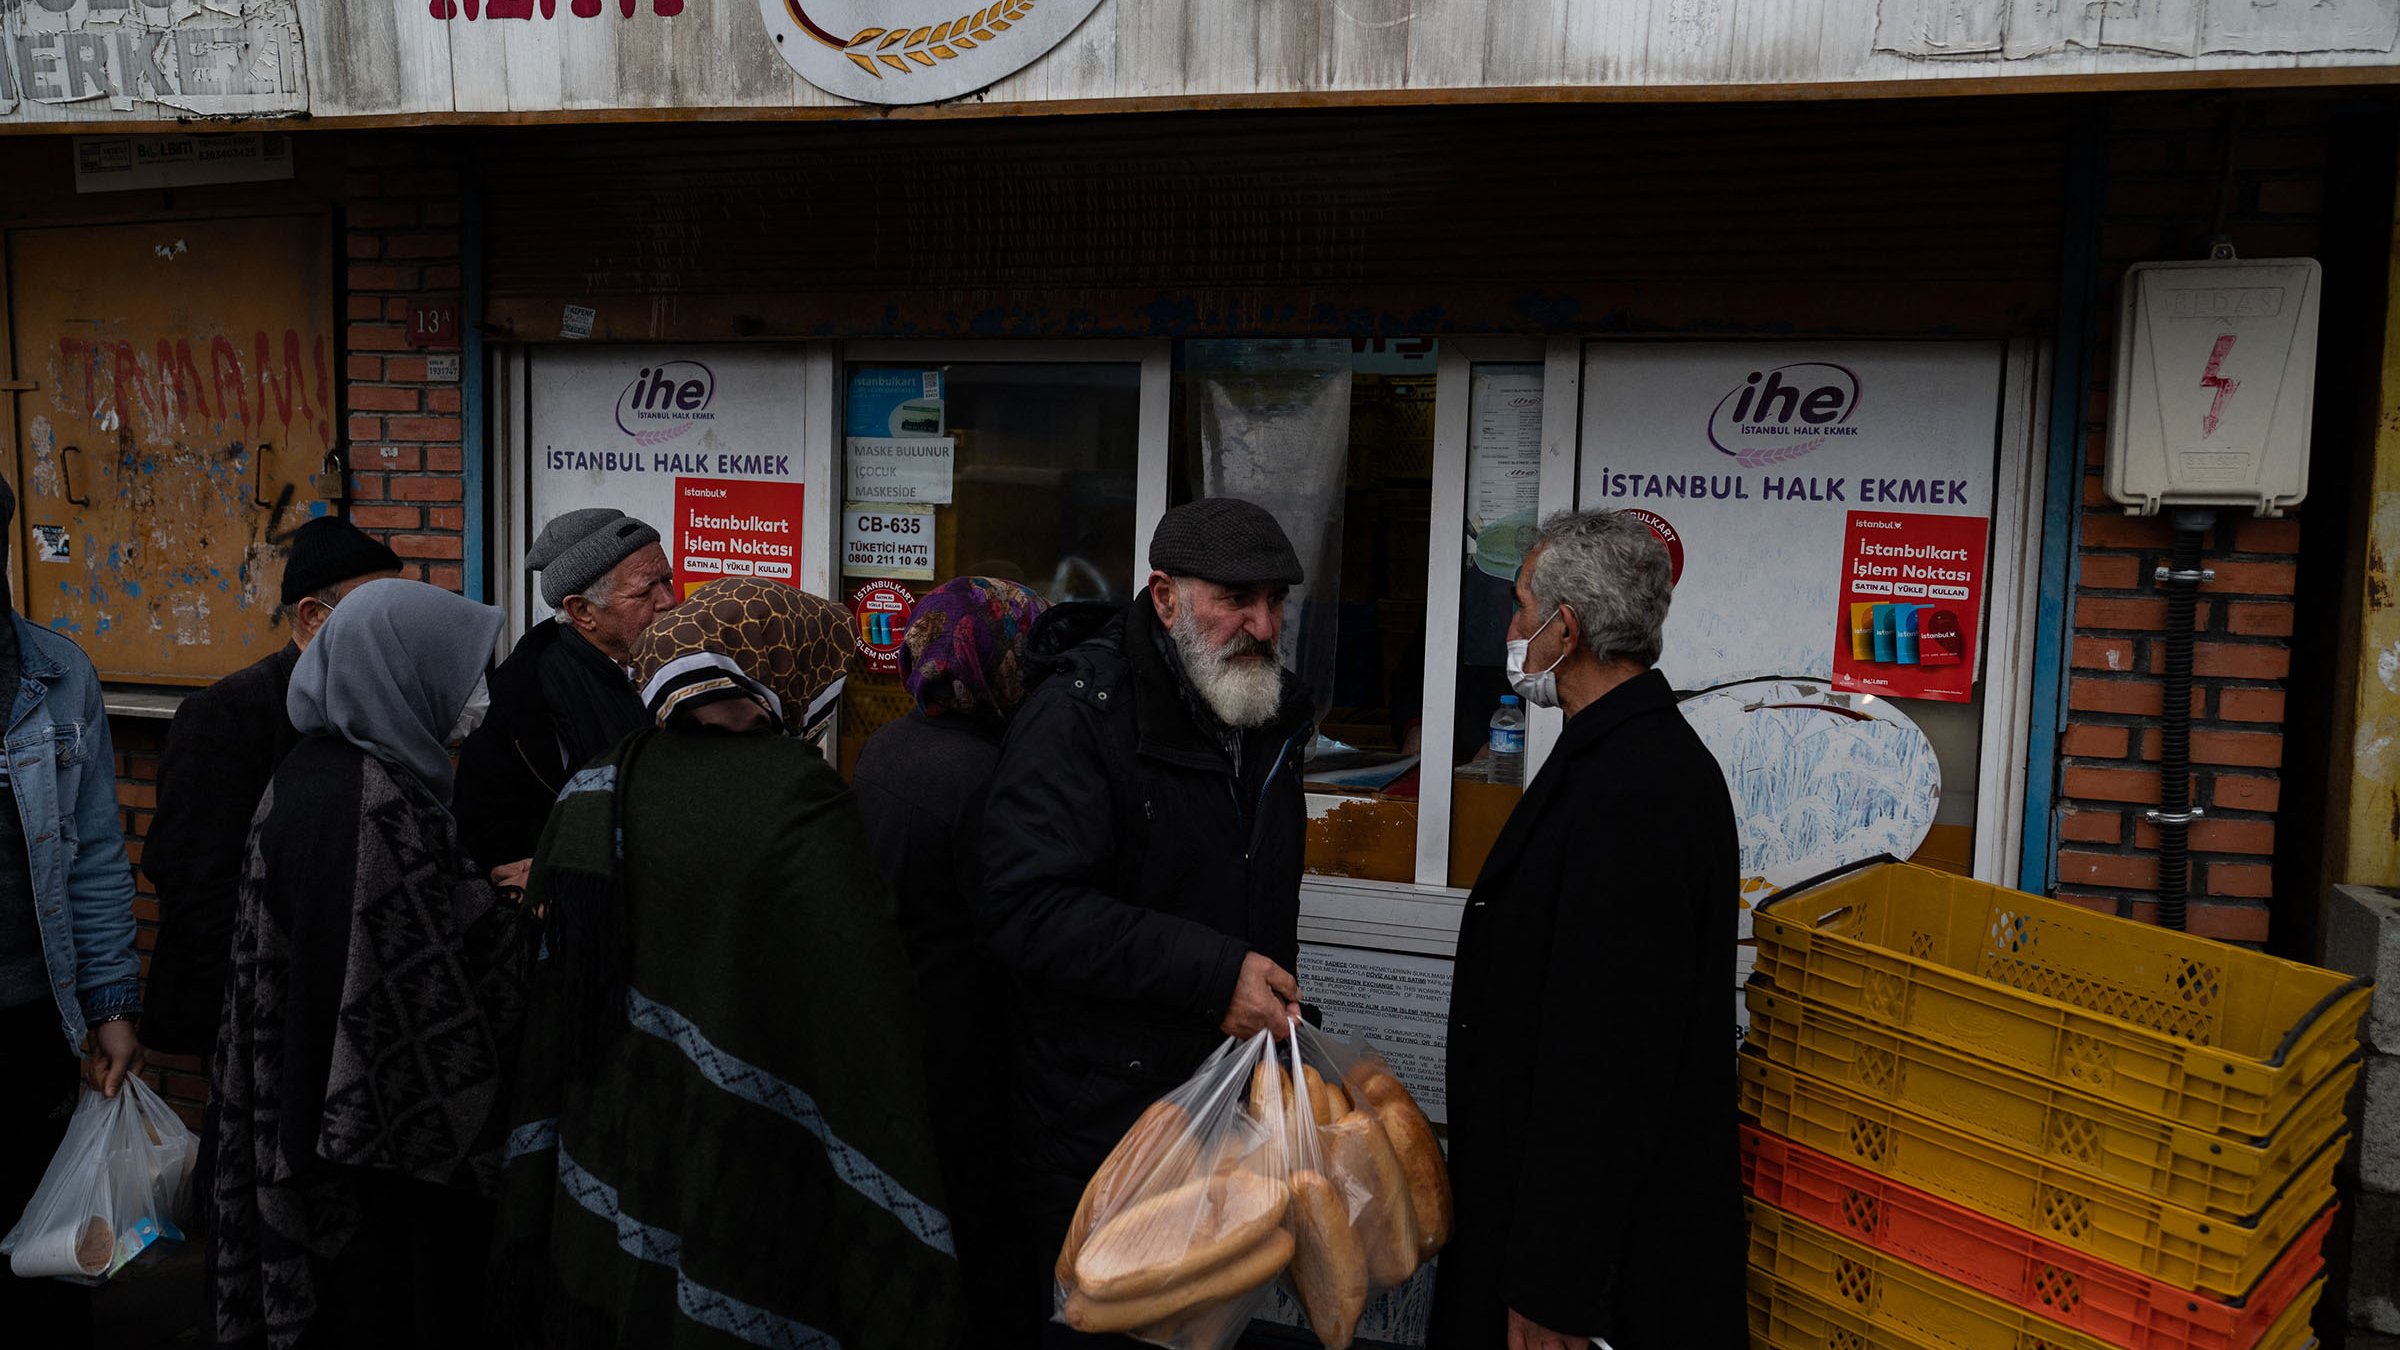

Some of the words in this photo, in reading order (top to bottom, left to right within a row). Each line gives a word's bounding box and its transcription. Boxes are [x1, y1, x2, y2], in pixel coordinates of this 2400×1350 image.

[632, 368, 705, 410] ihe
[1733, 371, 1845, 424] ihe
[637, 409, 670, 420] İSTANBUL
[672, 412, 690, 420] HALK
[692, 412, 715, 420] EKMEK
[1741, 423, 1789, 436] İSTANBUL
[1794, 426, 1820, 436] HALK
[1824, 426, 1858, 436] EKMEK
[855, 446, 893, 457] MASKE
[897, 446, 949, 457] BULUNUR
[547, 445, 645, 473] İSTANBUL
[654, 453, 709, 474] HALK
[718, 454, 789, 475] EKMEK
[855, 466, 896, 479] (ÇOCUK
[1602, 467, 1749, 500] İSTANBUL
[1762, 477, 1845, 501] HALK
[1859, 478, 1968, 505] EKMEK
[690, 508, 789, 533] İstanbulkart
[858, 516, 921, 534] CB-635
[685, 530, 726, 553] İşlem
[729, 538, 793, 557] Noktası
[849, 541, 895, 553] TÜKETİCİ
[898, 545, 927, 555] HATTI
[1860, 537, 1968, 562] İstanbulkart
[687, 560, 709, 569] SATIN
[848, 554, 873, 564] 0800
[877, 555, 894, 564] 211
[900, 556, 911, 565] 10
[914, 556, 927, 566] 49
[726, 562, 750, 572] YÜKLE
[758, 565, 788, 574] KULLAN
[1853, 557, 1898, 577] İşlem
[1902, 564, 1971, 582] Noktası
[853, 580, 915, 605] İSTANBULKART
[1855, 583, 1879, 591] SATIN
[1898, 585, 1924, 594] YÜKLE
[1932, 588, 1965, 597] KULLAN
[1324, 959, 1347, 967] SADECE
[1362, 981, 1393, 989] EXCHANGE
[1420, 1010, 1448, 1019] YAPILMAS
[1382, 1050, 1414, 1059] LEKTRONİK
